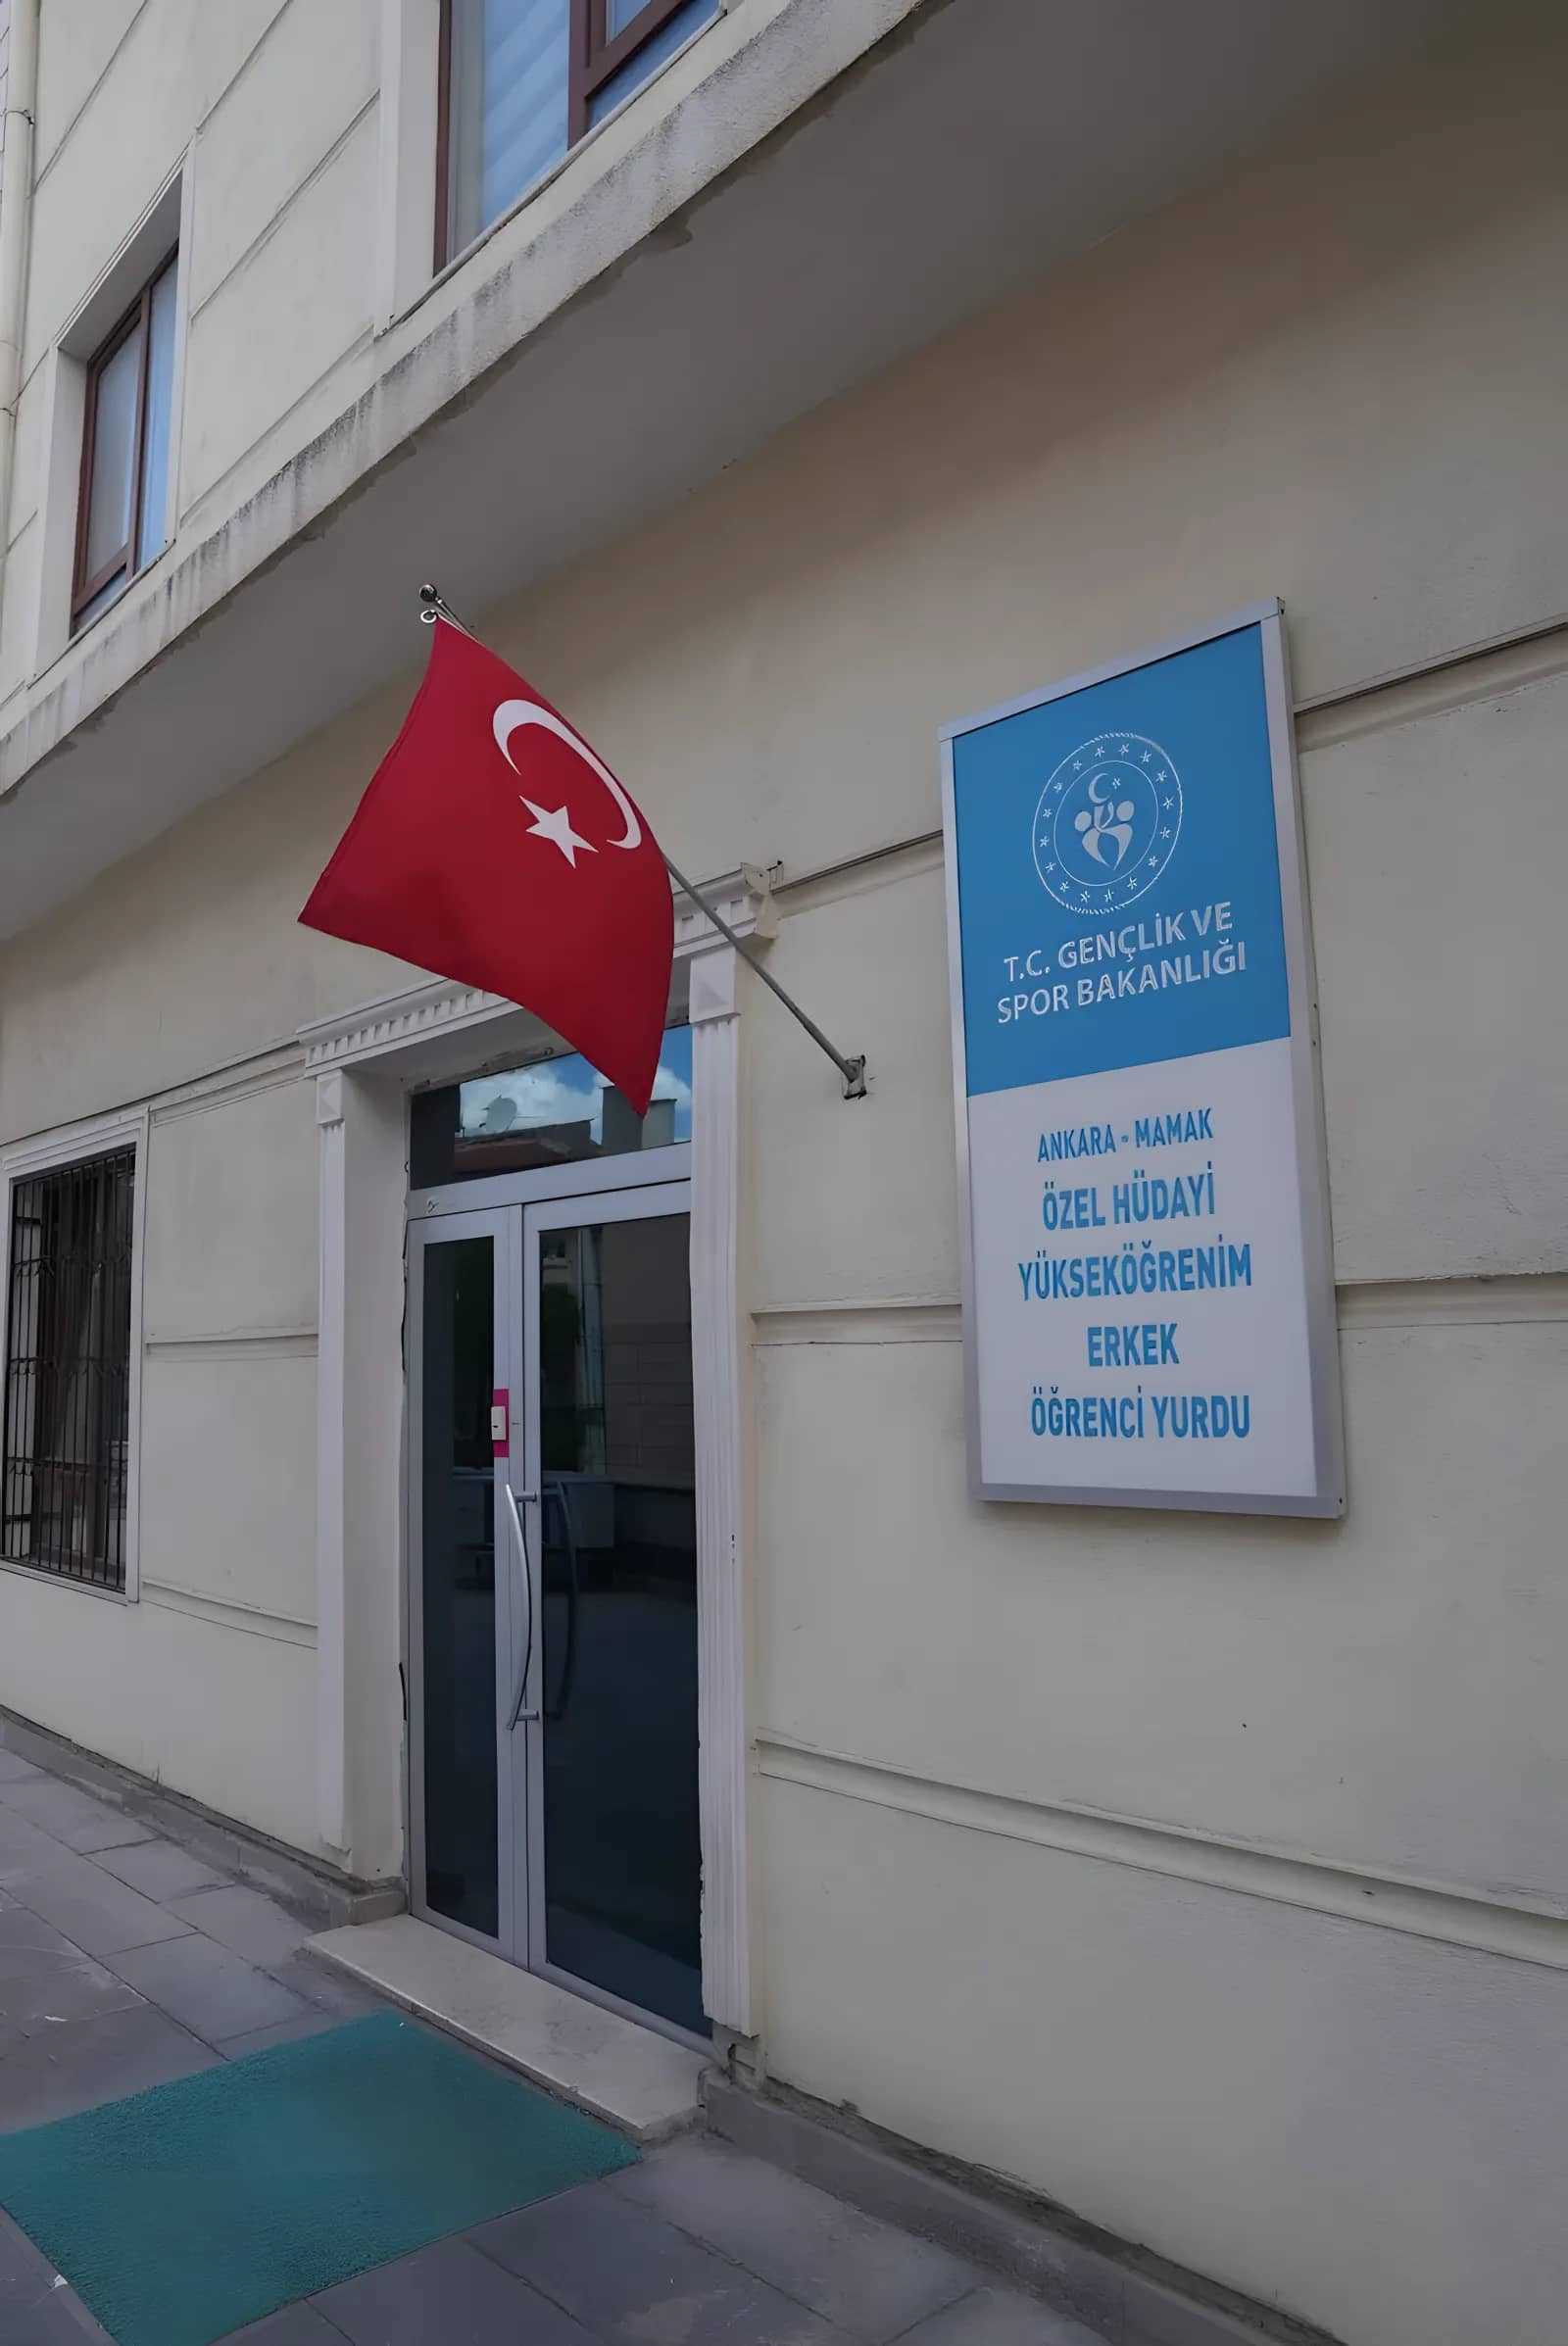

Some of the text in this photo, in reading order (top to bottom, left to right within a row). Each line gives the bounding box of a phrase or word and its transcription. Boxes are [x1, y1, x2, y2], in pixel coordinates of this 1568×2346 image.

[1004, 902, 1233, 982] T.C. GENÇLİK VE
[998, 939, 1247, 1024] SPOR BAKANLIĞI
[1037, 1124, 1116, 1162] ANKARA
[1135, 1107, 1213, 1149] MAMAK
[1043, 1160, 1215, 1231] ÖZEL HÜDAYİ
[1018, 1234, 1251, 1301] YÜKSEKÖĞRENİM
[1087, 1323, 1180, 1367] ERKEK
[1031, 1385, 1250, 1439] ÖĞRENCİ YURDU
